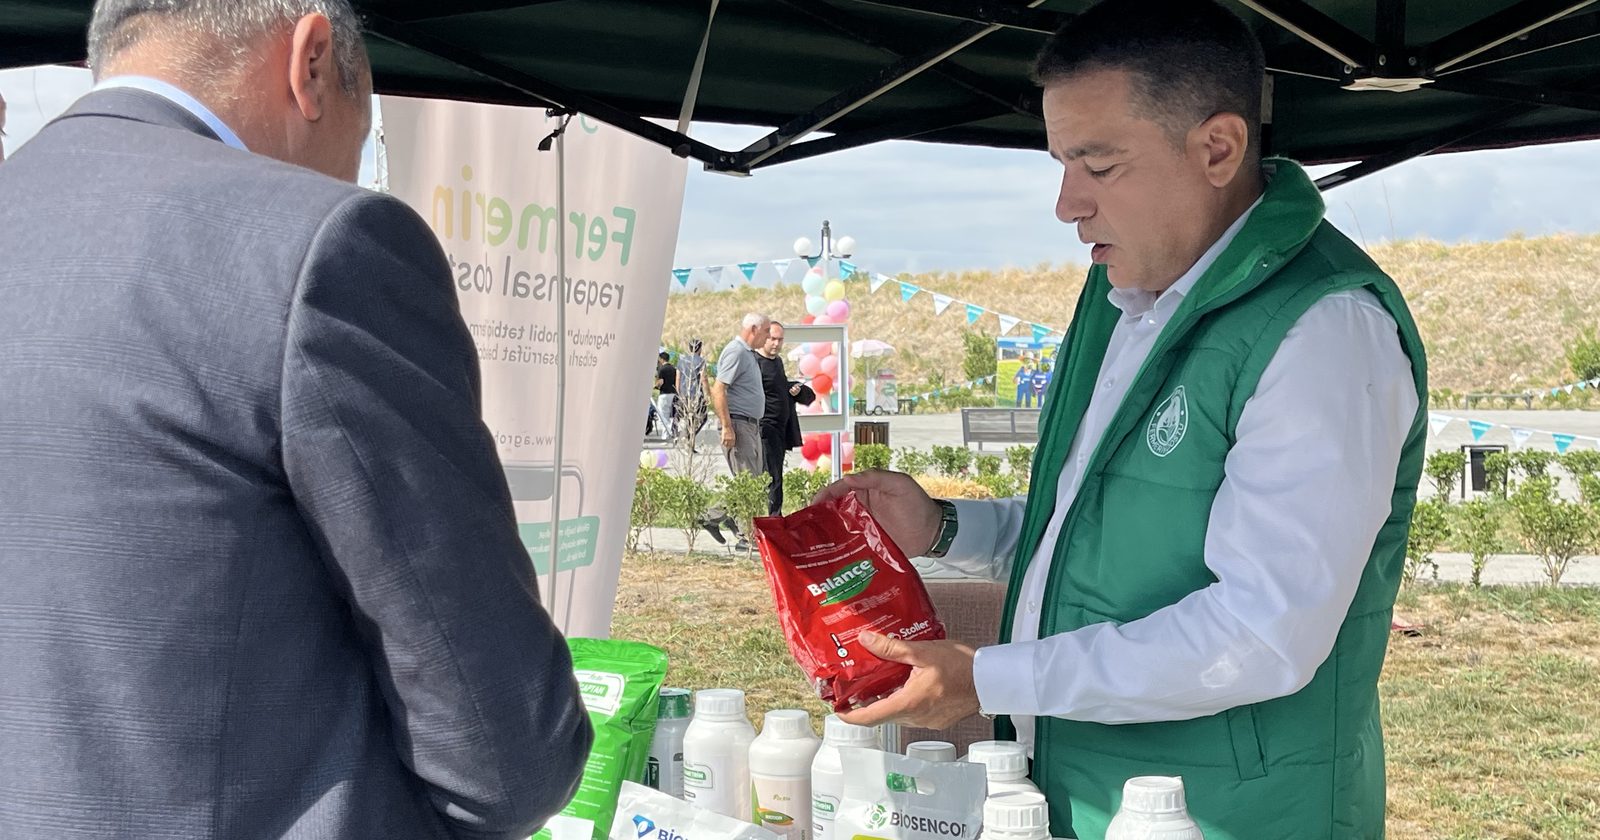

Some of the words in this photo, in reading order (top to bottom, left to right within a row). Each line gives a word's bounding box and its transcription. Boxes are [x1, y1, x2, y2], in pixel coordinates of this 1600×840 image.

[806, 559, 872, 597] Balance
[899, 620, 929, 638] Stoller
[845, 658, 855, 667] kg
